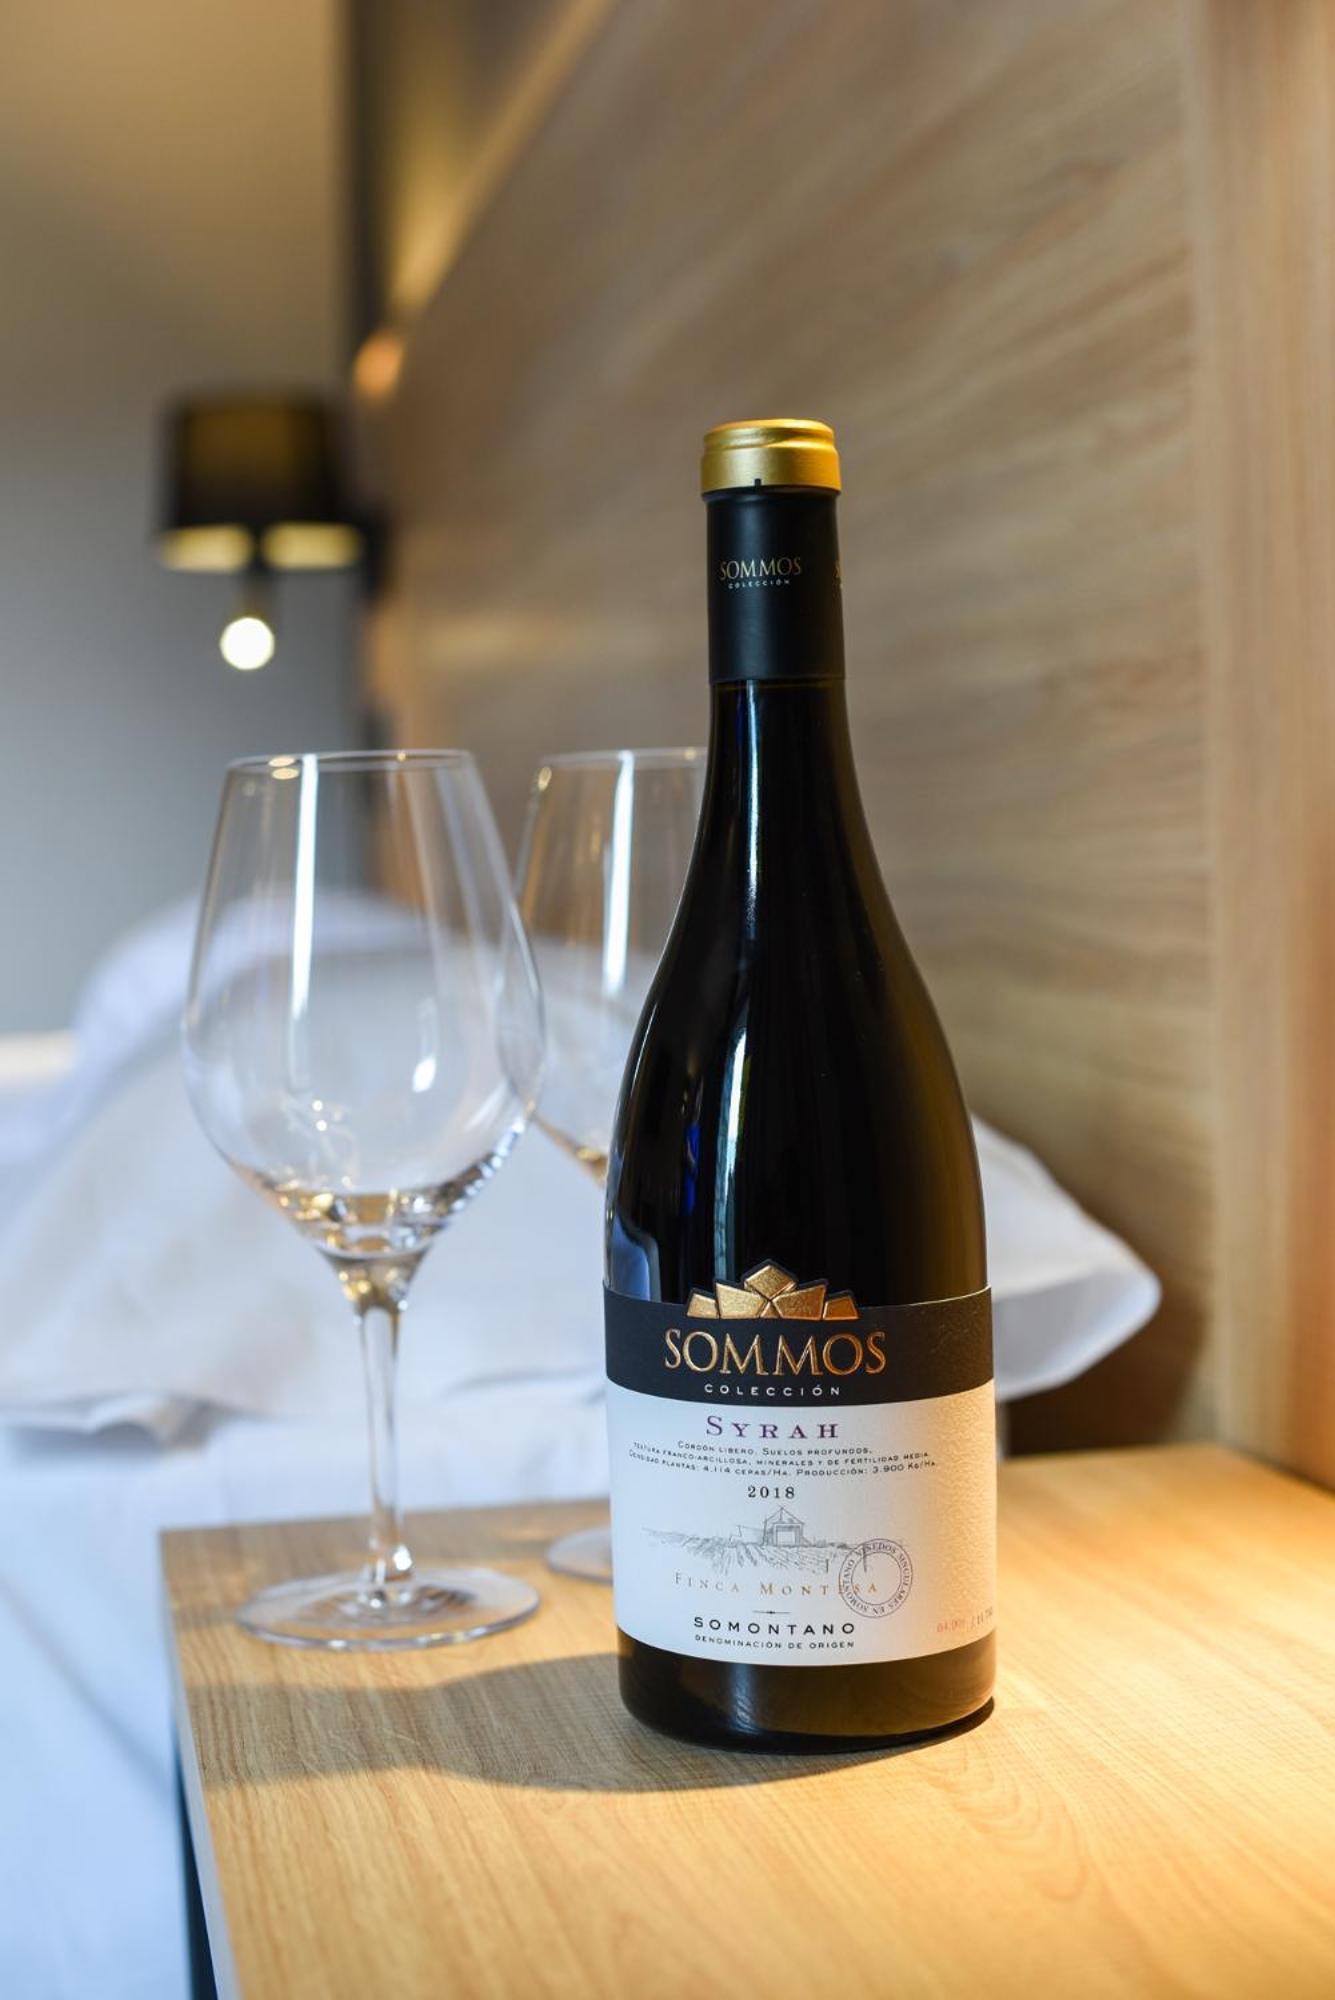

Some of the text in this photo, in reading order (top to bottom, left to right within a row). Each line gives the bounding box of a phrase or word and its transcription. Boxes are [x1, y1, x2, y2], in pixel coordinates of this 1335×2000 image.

[720, 557, 801, 581] SOMMOS
[664, 1328, 886, 1376] SOMMOS
[704, 1383, 841, 1397] COLECCIÓN
[706, 1415, 839, 1438] SYRAH
[762, 1447, 803, 1456] SUELOS
[747, 1485, 795, 1499] 2018
[675, 1571, 739, 1594] FINCA
[694, 1616, 855, 1635] SOMONTANO
[694, 1635, 855, 1649] DENOMINACIÓN DE ORIGEN
